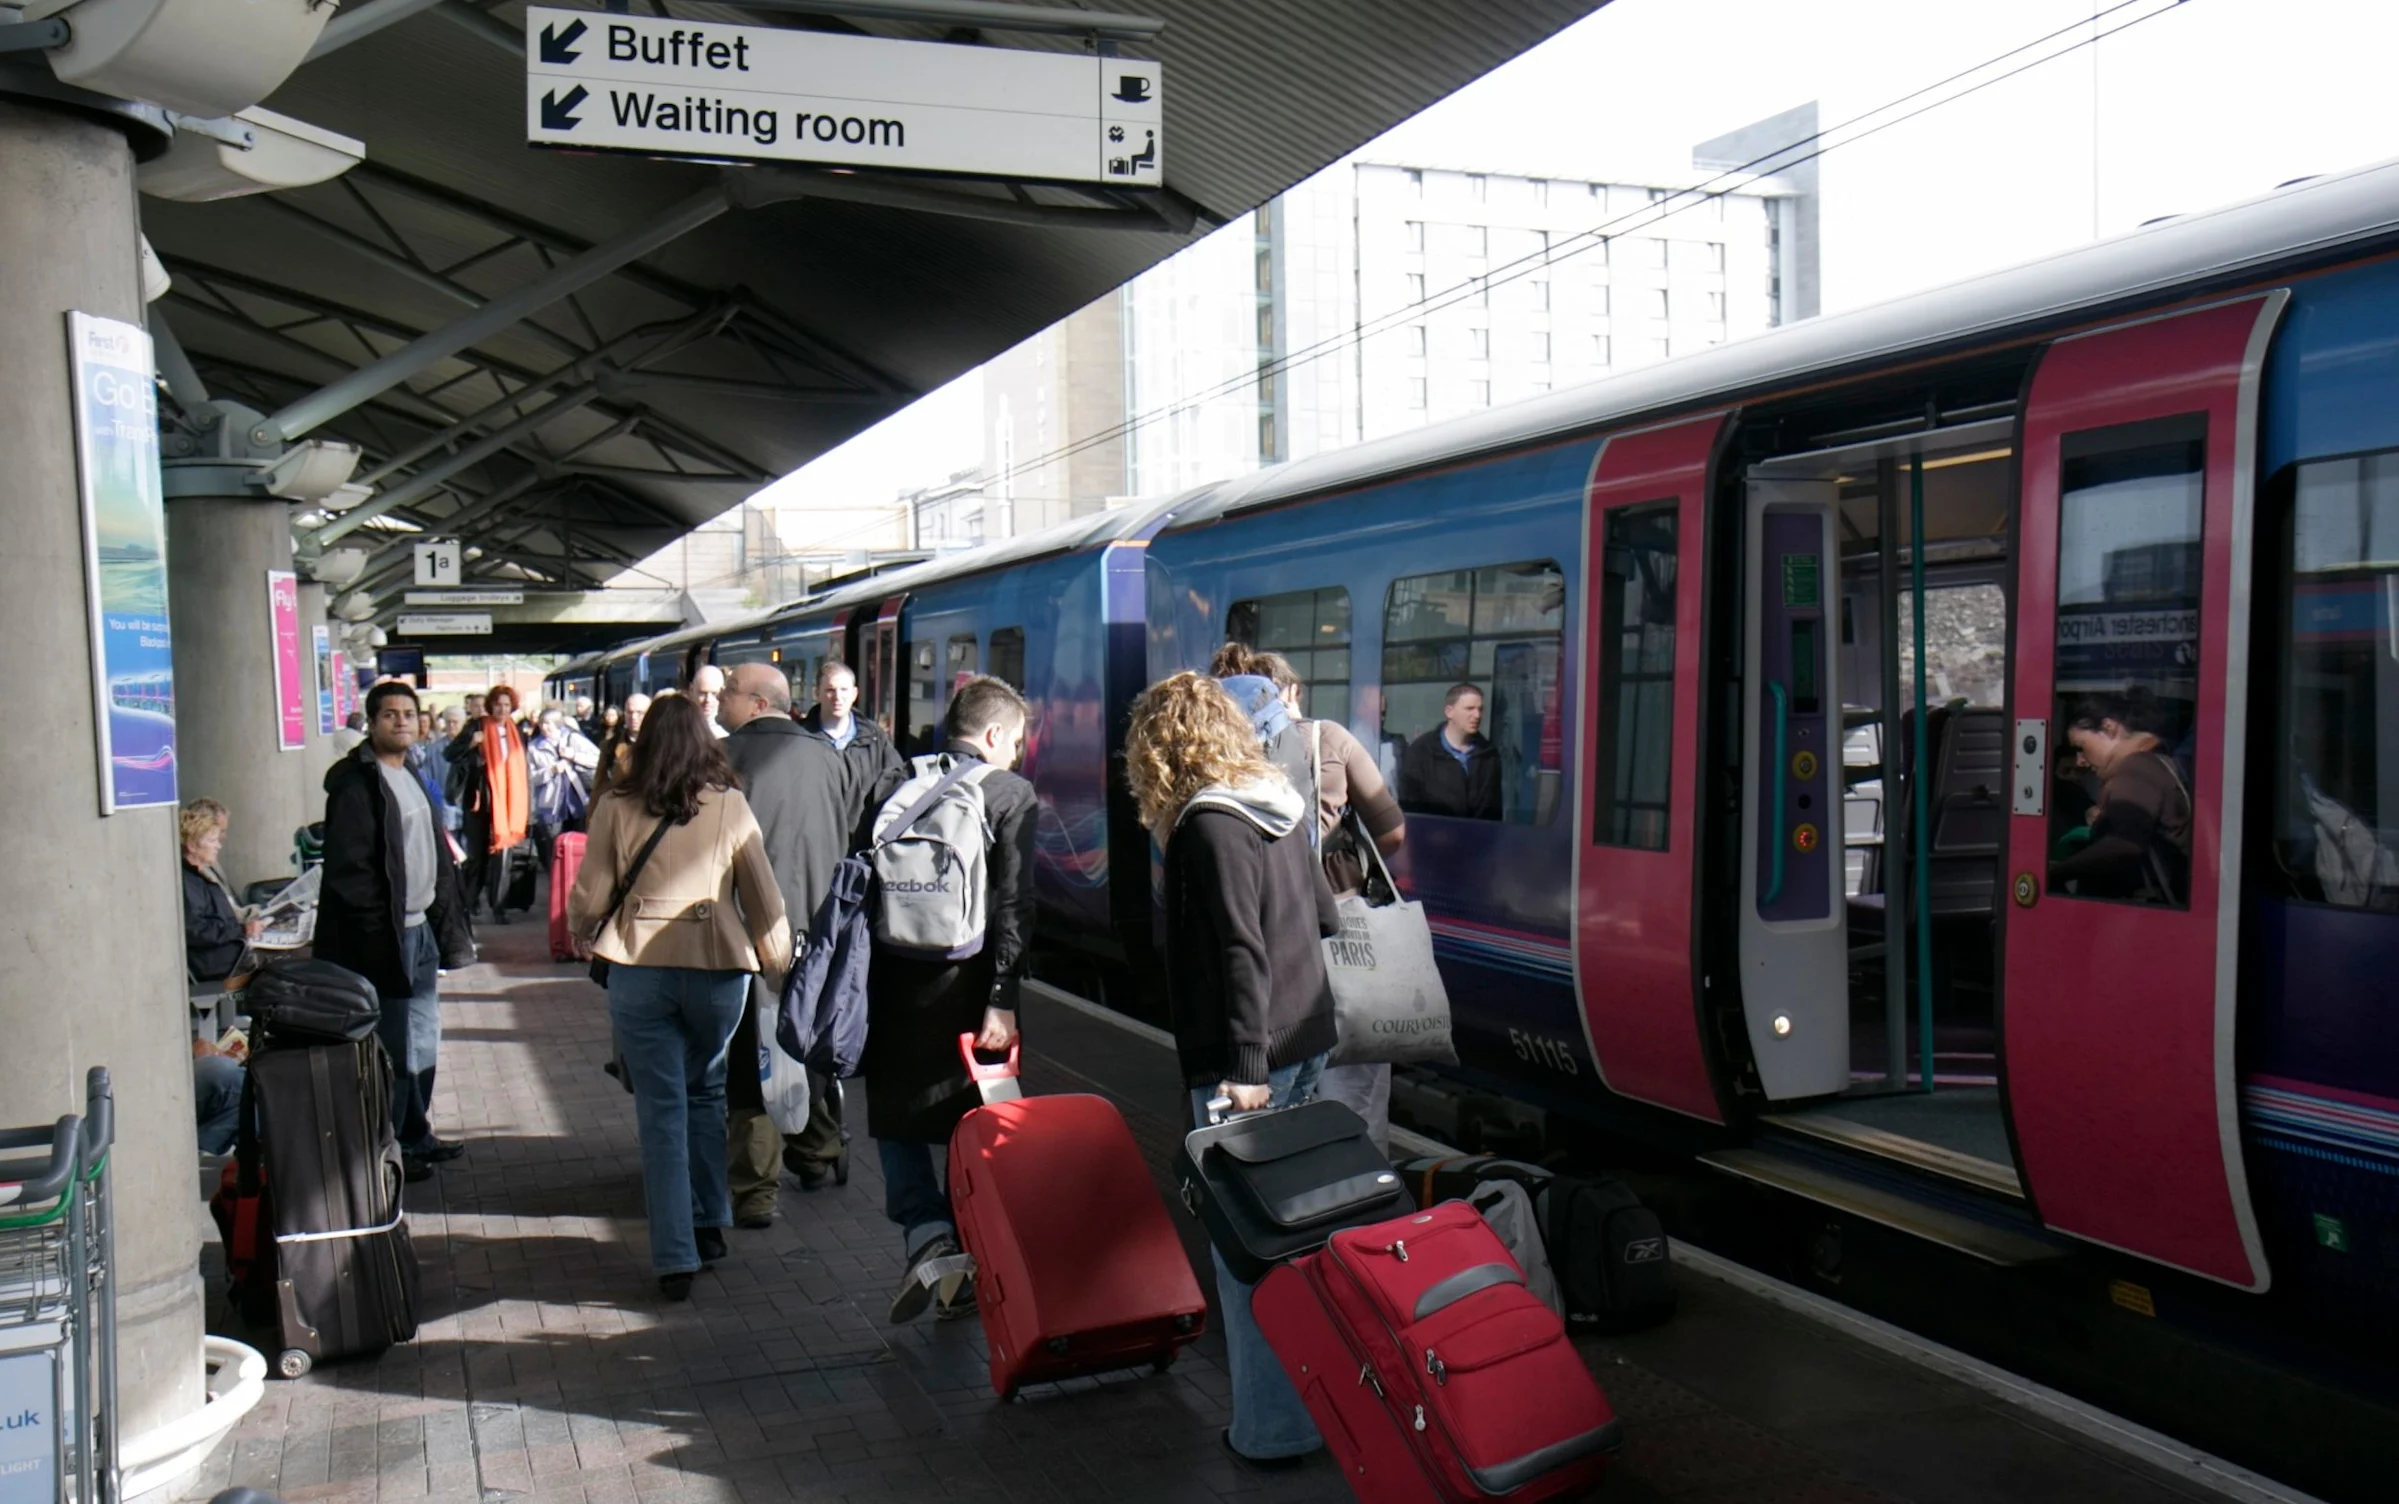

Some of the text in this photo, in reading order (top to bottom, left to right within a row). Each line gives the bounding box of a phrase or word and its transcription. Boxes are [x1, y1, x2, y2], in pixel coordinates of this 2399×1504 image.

[607, 25, 750, 72] Buffet
[610, 90, 905, 148] Waiting room
[93, 371, 136, 410] Go
[425, 551, 449, 578] 1a
[109, 618, 126, 630] You
[1329, 940, 1377, 968] PARIS
[1508, 1027, 1579, 1076] 51115
